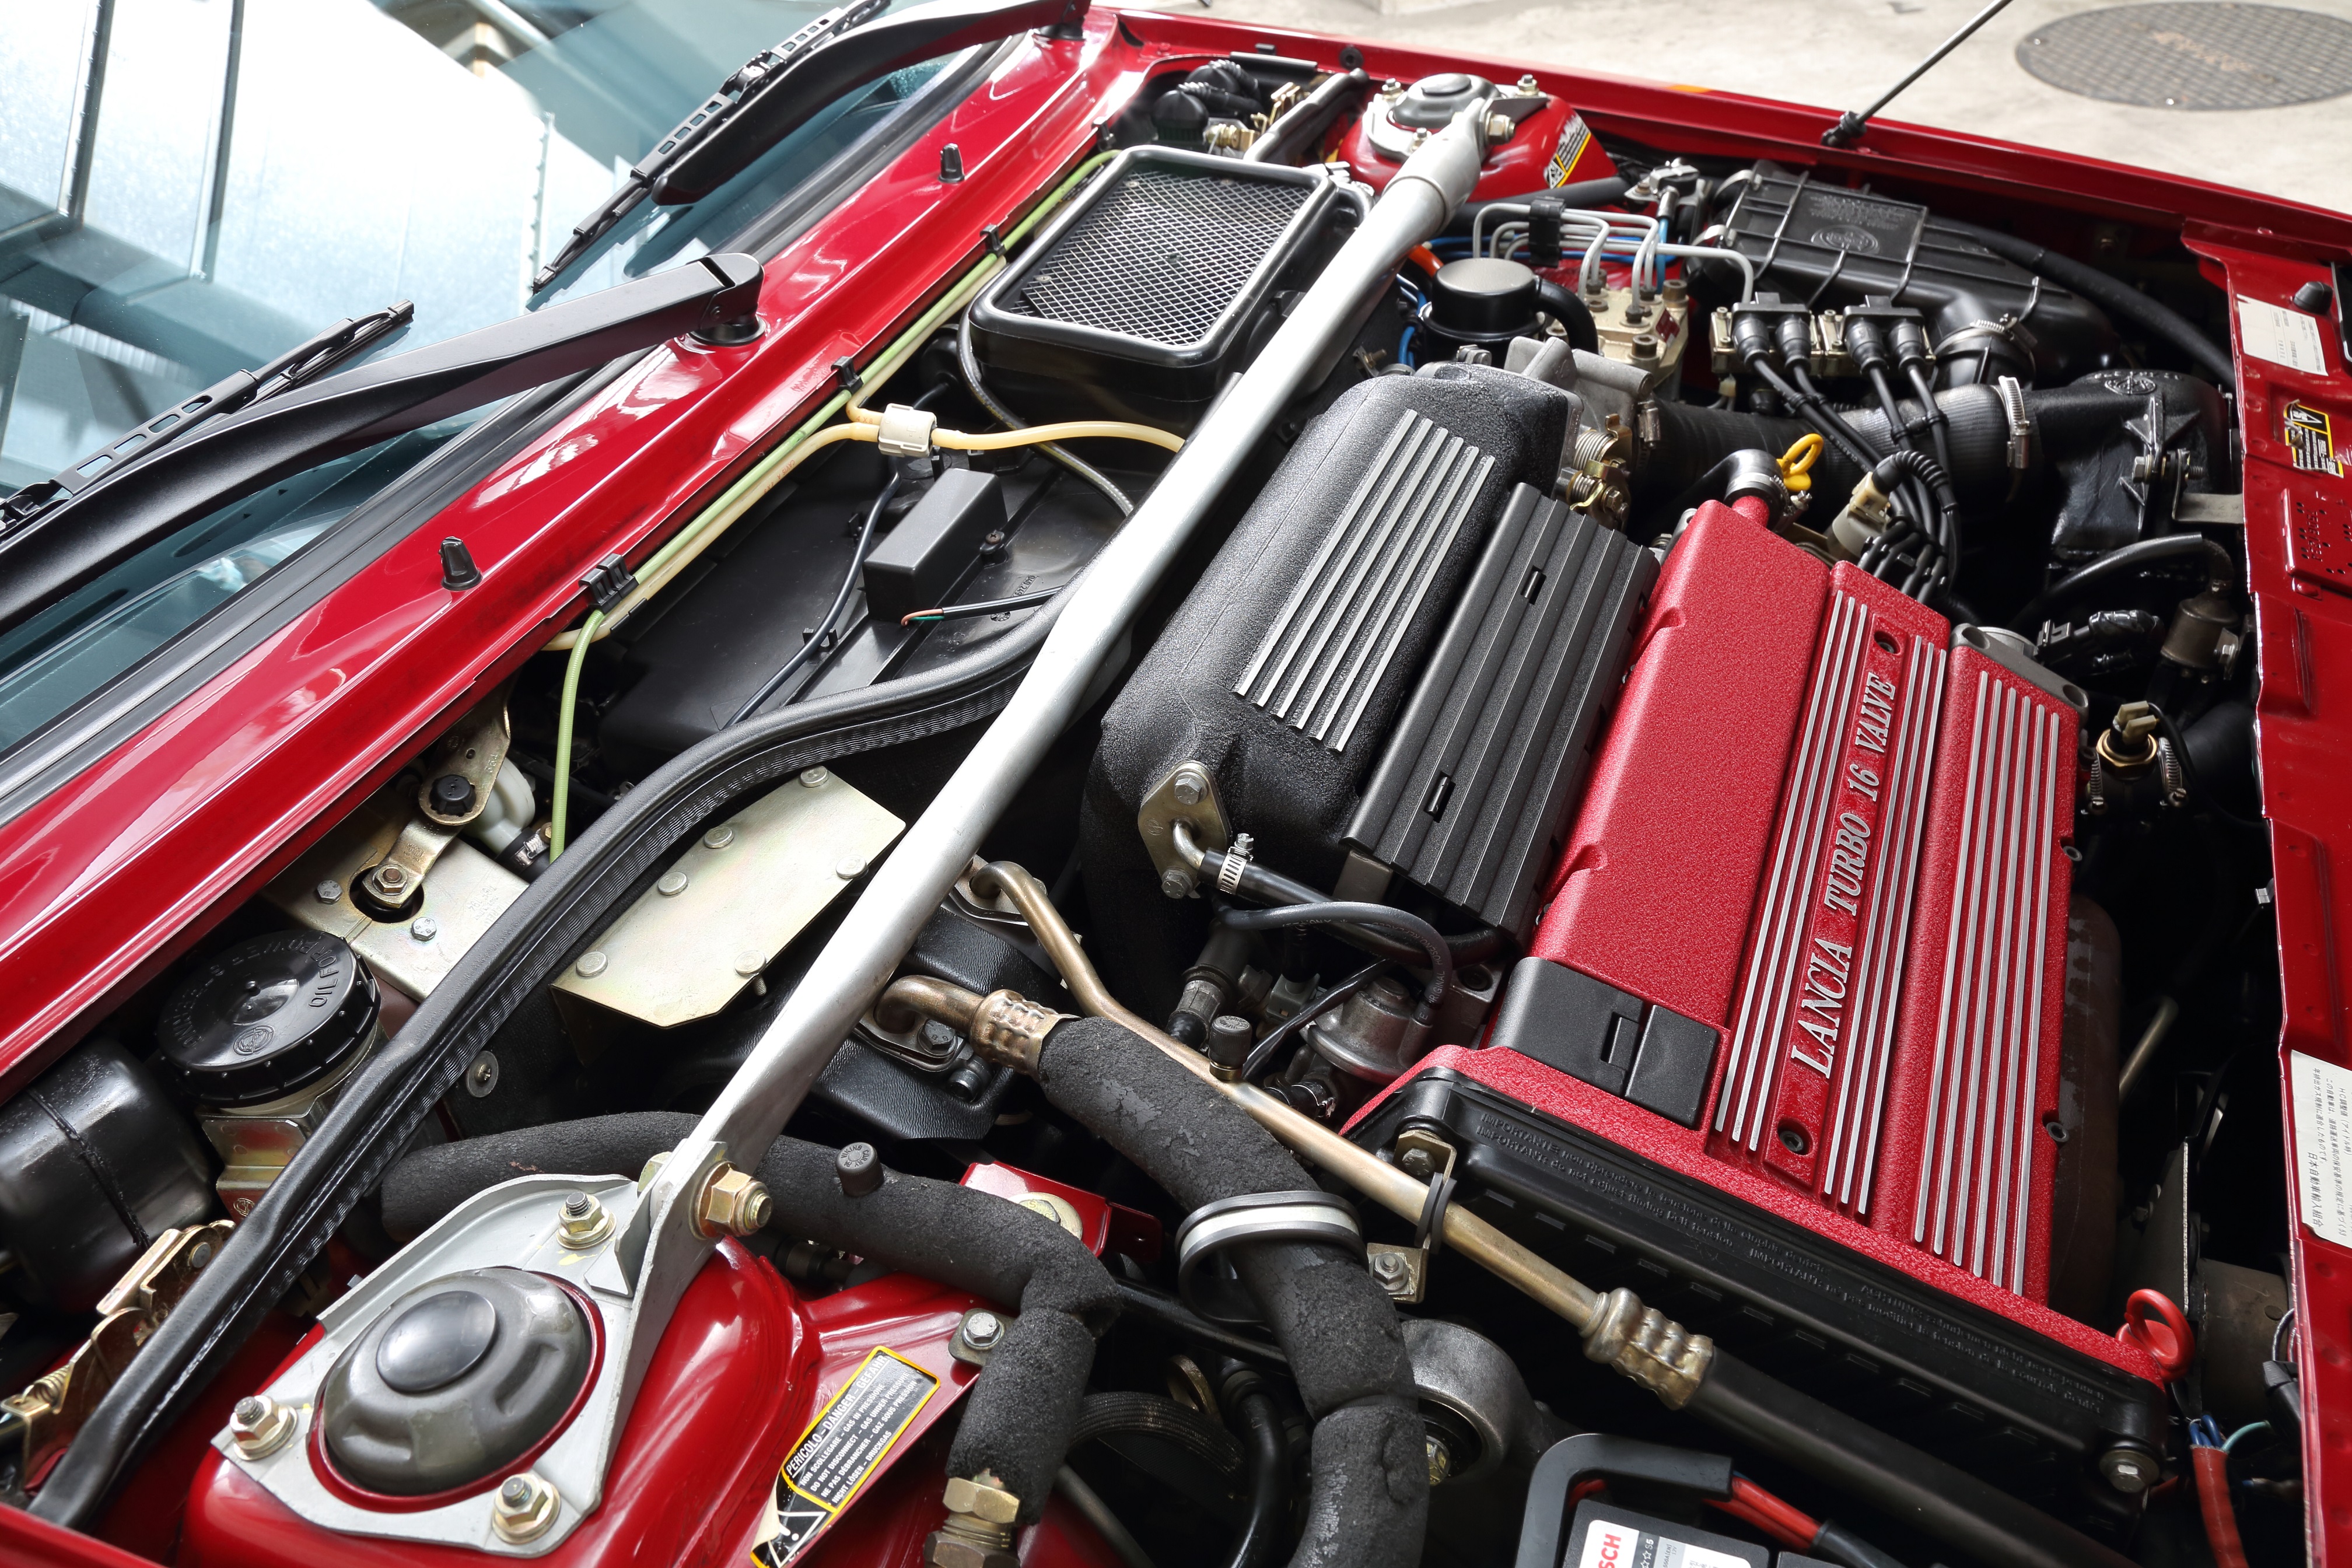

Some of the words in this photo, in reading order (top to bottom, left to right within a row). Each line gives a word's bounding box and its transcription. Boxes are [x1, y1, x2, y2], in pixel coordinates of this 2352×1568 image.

[1856, 671, 1896, 758] VALVE
[1849, 764, 1880, 802] 16
[1824, 812, 1871, 917] TURBO
[309, 978, 338, 1008] OIL
[310, 944, 340, 978] FOR
[1791, 937, 1852, 1079] LANCIA
[840, 1144, 862, 1158] VIKING
[854, 1149, 870, 1168] CURRY
[1477, 1125, 1548, 1165] IMPORTANT:
[1551, 1158, 1564, 1172] do
[1569, 1167, 1586, 1182] not
[1590, 1177, 1625, 1200] adjust
[1667, 1209, 1689, 1228] belt
[1692, 1221, 1734, 1248] tension
[1563, 1149, 1583, 1166] non
[1711, 1216, 1738, 1236] della
[784, 1432, 822, 1475] PERICOLO
[822, 1392, 856, 1429] DANGER
[857, 1353, 887, 1388] GEFAHR
[800, 1471, 813, 1486] NON
[810, 1436, 842, 1473] SCOLLEGARE
[844, 1419, 855, 1432] GAS
[853, 1412, 861, 1420] IN
[859, 1382, 885, 1413] PRESSIONE
[810, 1480, 821, 1492] DO
[818, 1469, 831, 1482] NOT
[827, 1434, 859, 1470] DISCONNECT
[860, 1416, 873, 1430] GAS
[870, 1397, 888, 1418] UNDER
[884, 1370, 909, 1399] PRESSURE
[821, 1487, 831, 1498] NE
[828, 1475, 841, 1489] PAS
[837, 1437, 871, 1476] DÉBRANCHER
[872, 1420, 884, 1434] GAZ
[881, 1405, 896, 1422] SOUS
[893, 1380, 918, 1407] PRESSION
[831, 1484, 849, 1503] NICHT
[845, 1464, 864, 1485] LÖSEN
[865, 1430, 892, 1461] DRUCKGAS
